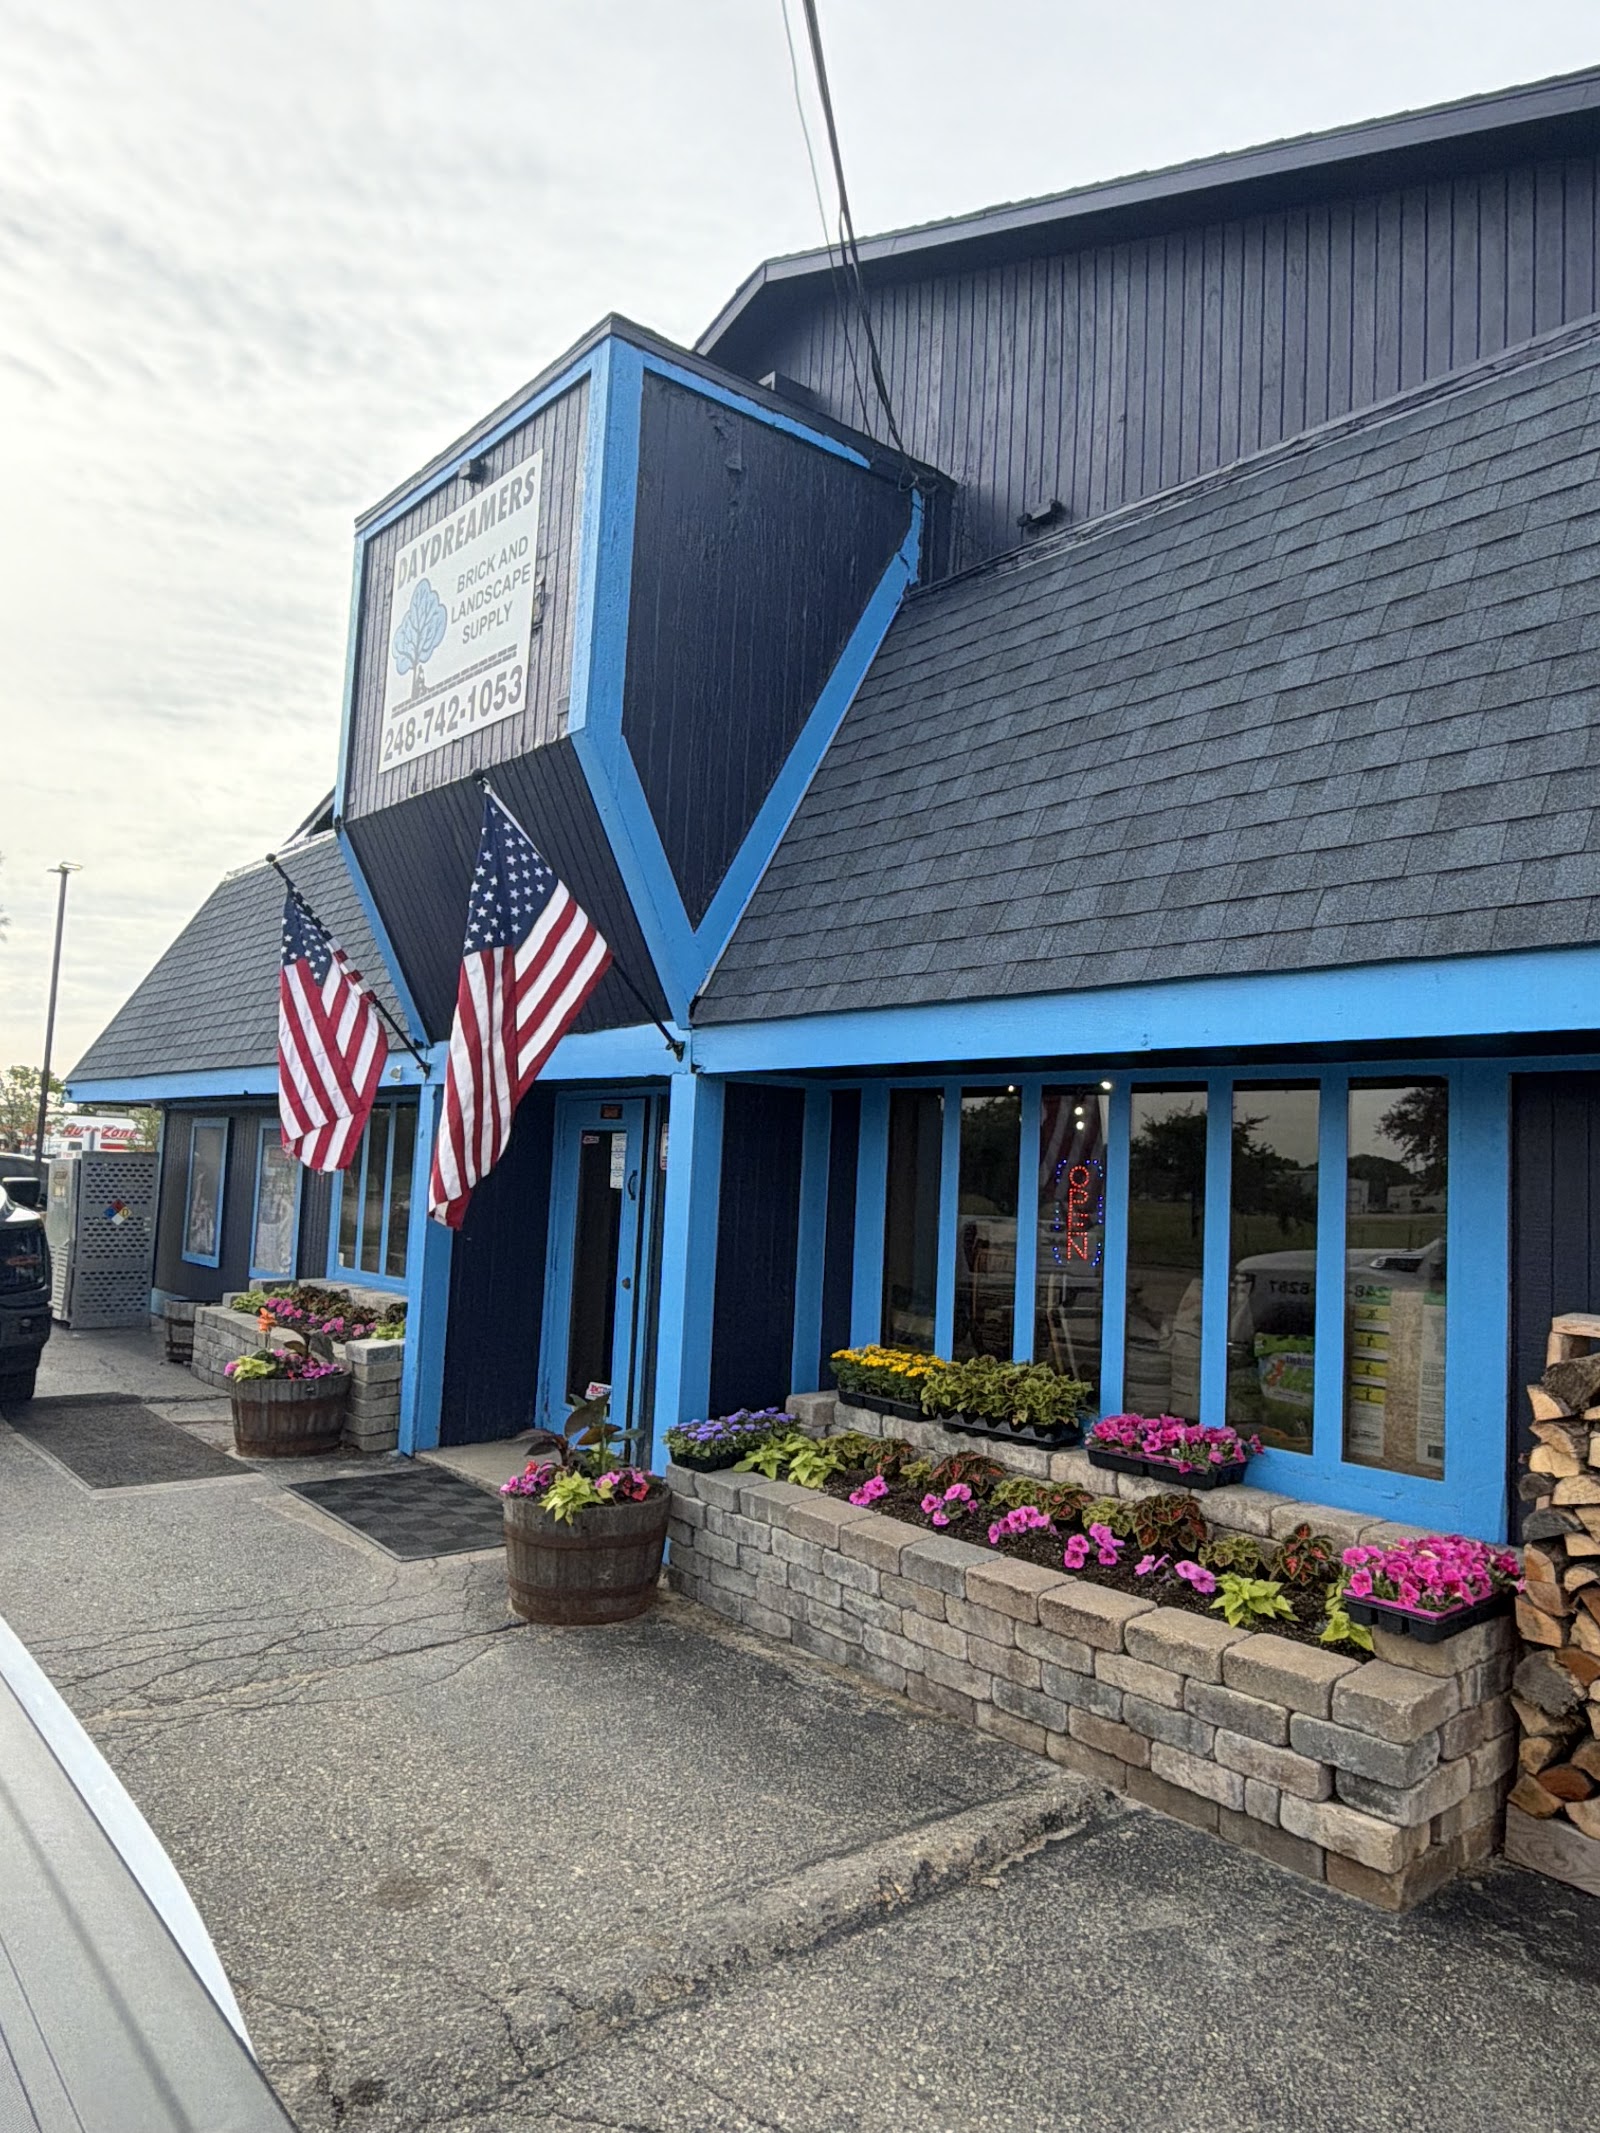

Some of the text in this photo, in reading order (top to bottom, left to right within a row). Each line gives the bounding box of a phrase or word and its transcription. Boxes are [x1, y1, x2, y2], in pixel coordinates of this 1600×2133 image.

[398, 466, 536, 591] DAYDREAMERS
[457, 535, 529, 594] BRICK AND
[451, 562, 532, 625] LANDSCAPE
[462, 600, 514, 645] SUPPLY
[383, 664, 523, 763] 248-742-1053
[1067, 1165, 1090, 1261] OPEN
